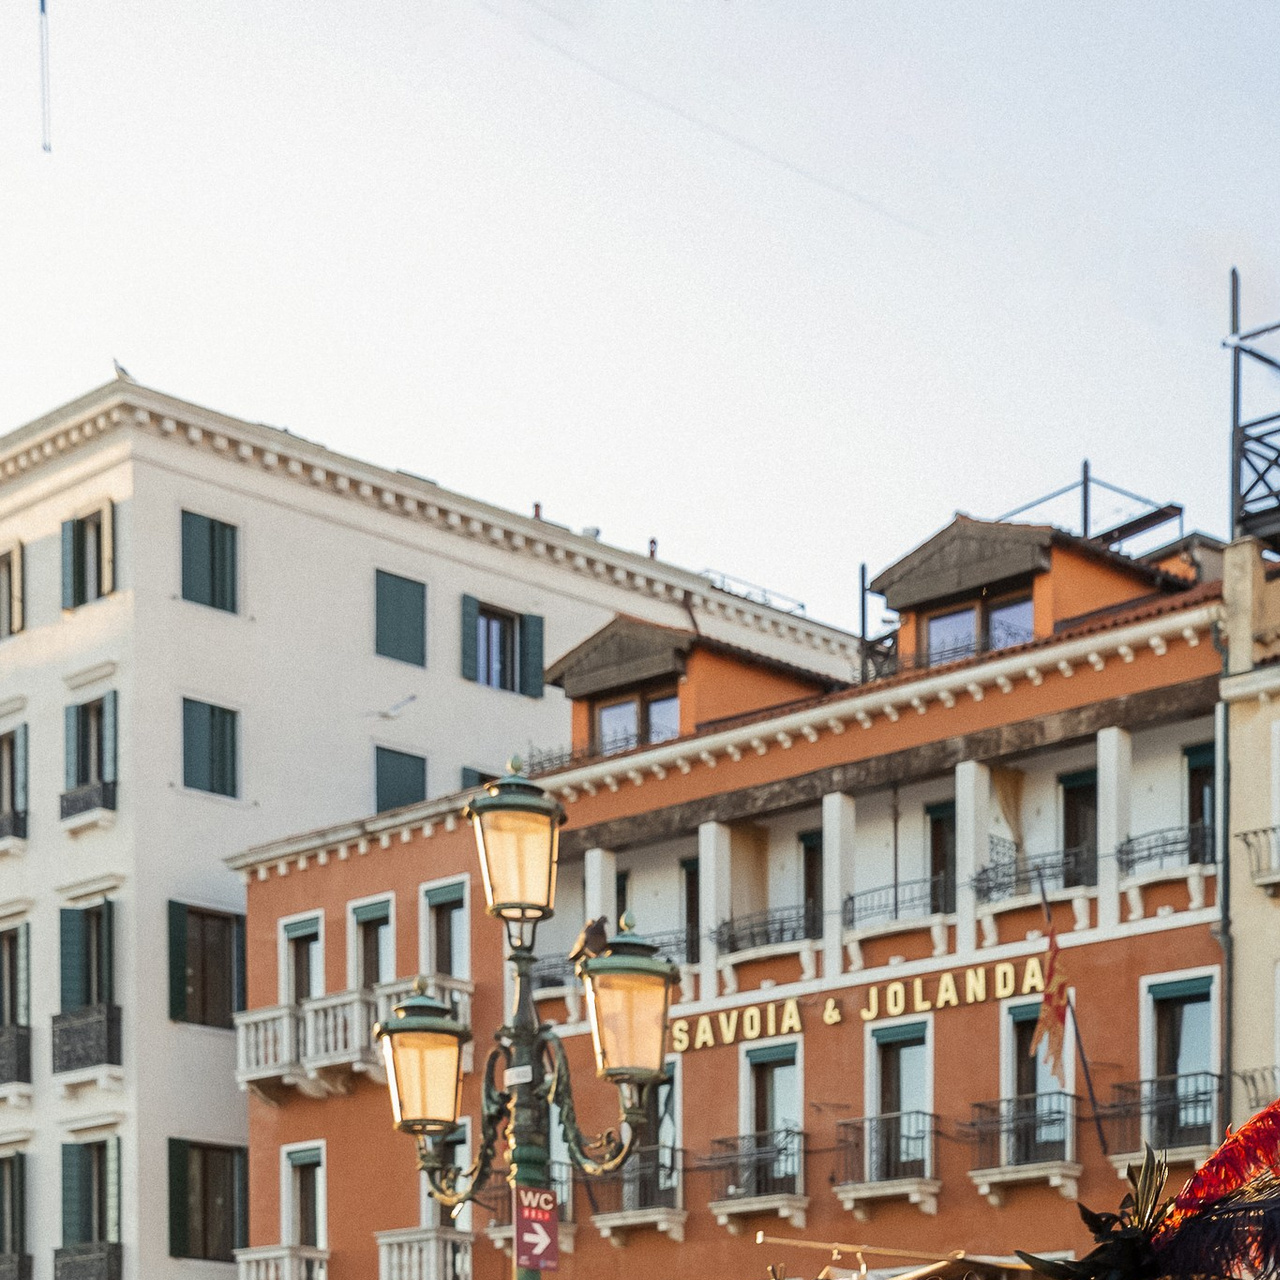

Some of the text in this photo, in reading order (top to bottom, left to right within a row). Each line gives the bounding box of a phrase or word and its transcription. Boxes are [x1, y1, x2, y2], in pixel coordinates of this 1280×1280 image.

[672, 956, 1045, 1054] SAVOIA & JOLANDA
[520, 1189, 554, 1211] WC
